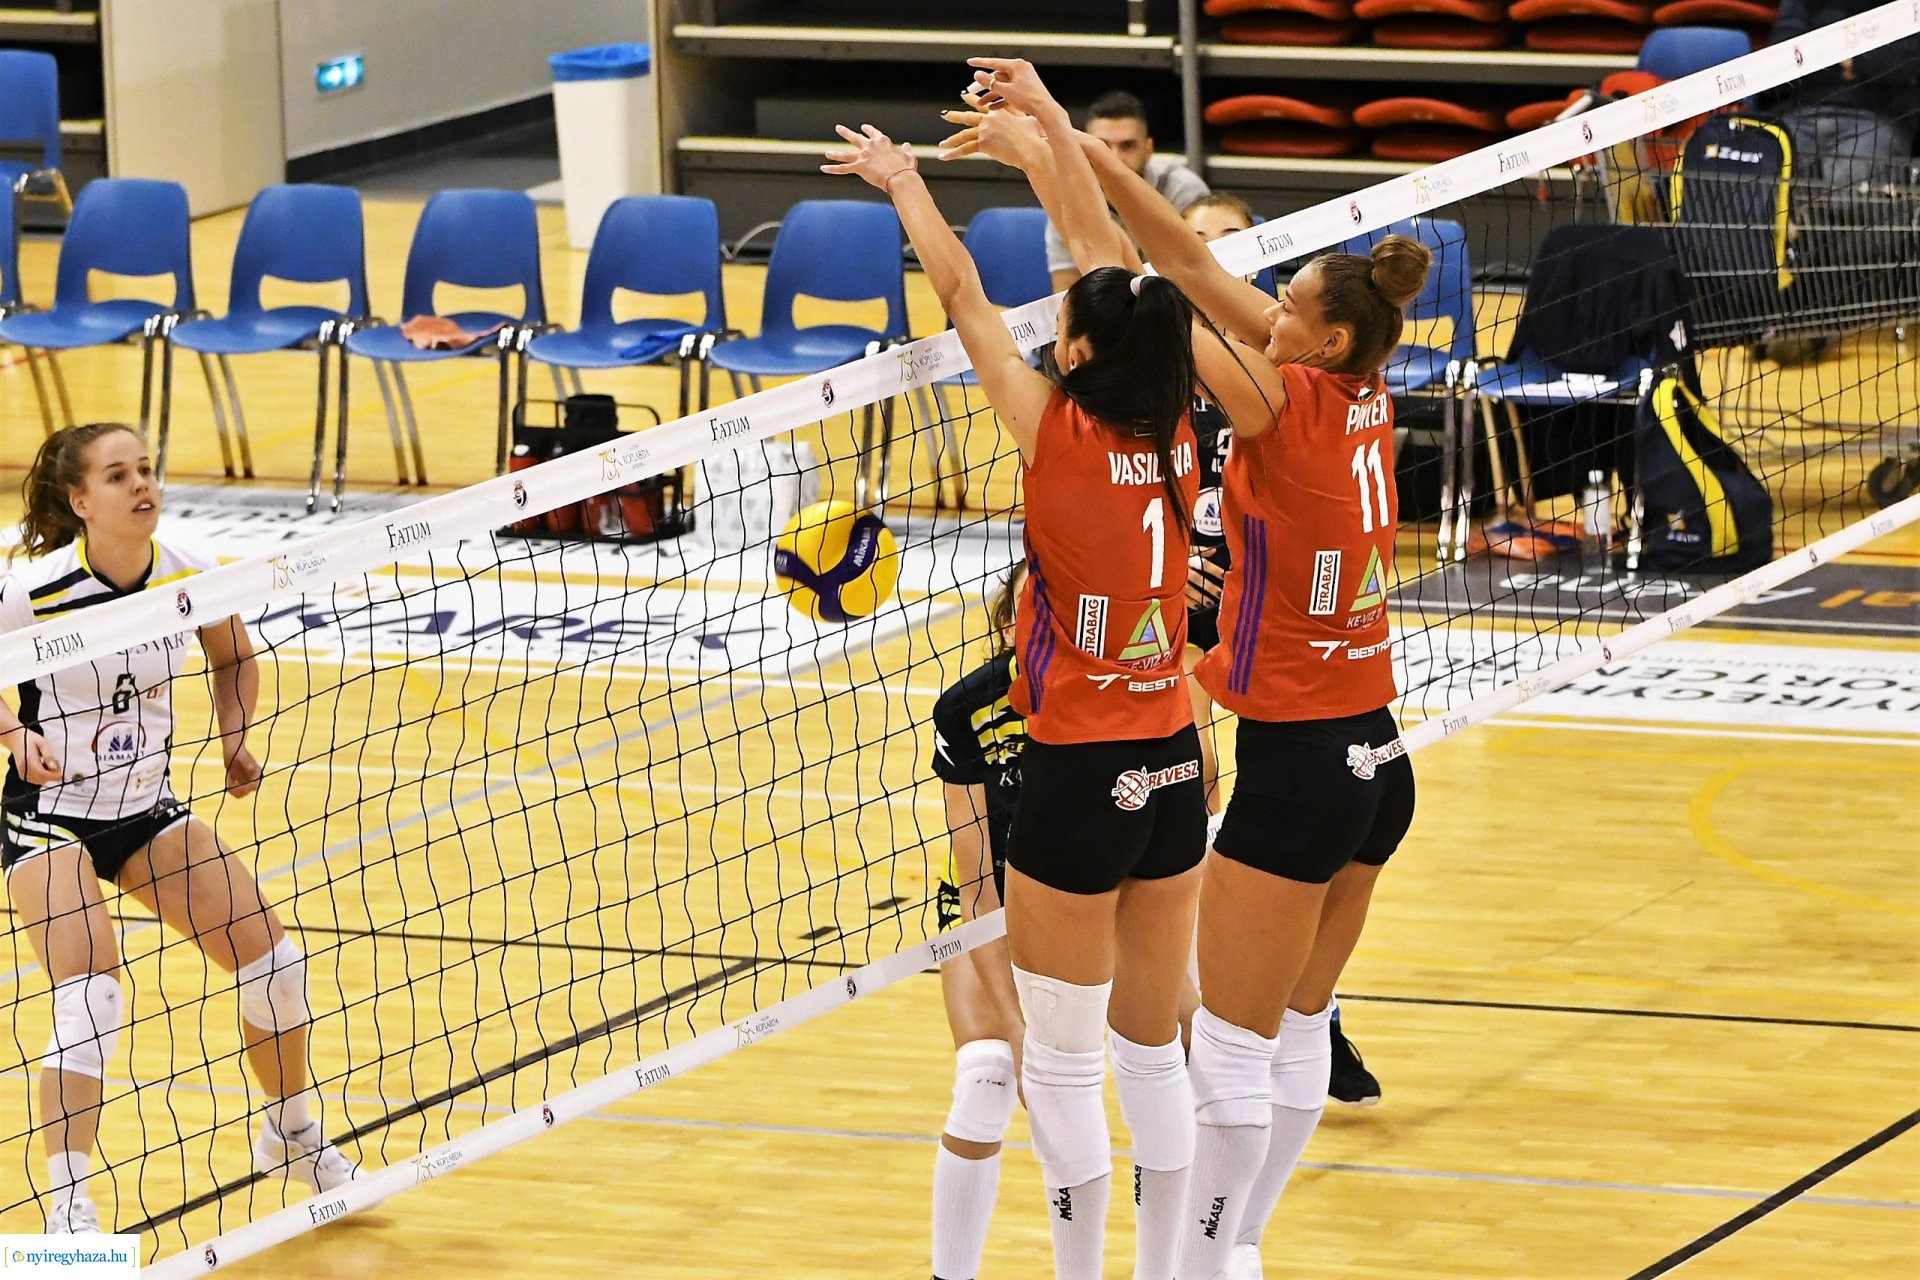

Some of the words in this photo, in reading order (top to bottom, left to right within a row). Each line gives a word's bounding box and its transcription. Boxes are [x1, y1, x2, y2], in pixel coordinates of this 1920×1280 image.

[1498, 150, 1530, 173] FATUM
[1257, 233, 1294, 255] FATUM
[1011, 321, 1036, 341] TUM
[709, 415, 751, 441] FATUM
[1108, 441, 1193, 486] VASILVA
[1351, 438, 1389, 533] 11
[385, 520, 432, 549] FATUM
[1142, 497, 1165, 589] 1
[1318, 554, 1334, 612] STRABAG
[33, 632, 84, 662] FATUM
[930, 940, 962, 961] FATUM
[635, 1064, 671, 1087] FATUM
[308, 1200, 347, 1224] FATUM
[1059, 1187, 1072, 1221] MIKA
[1204, 1196, 1227, 1240] MIKASA
